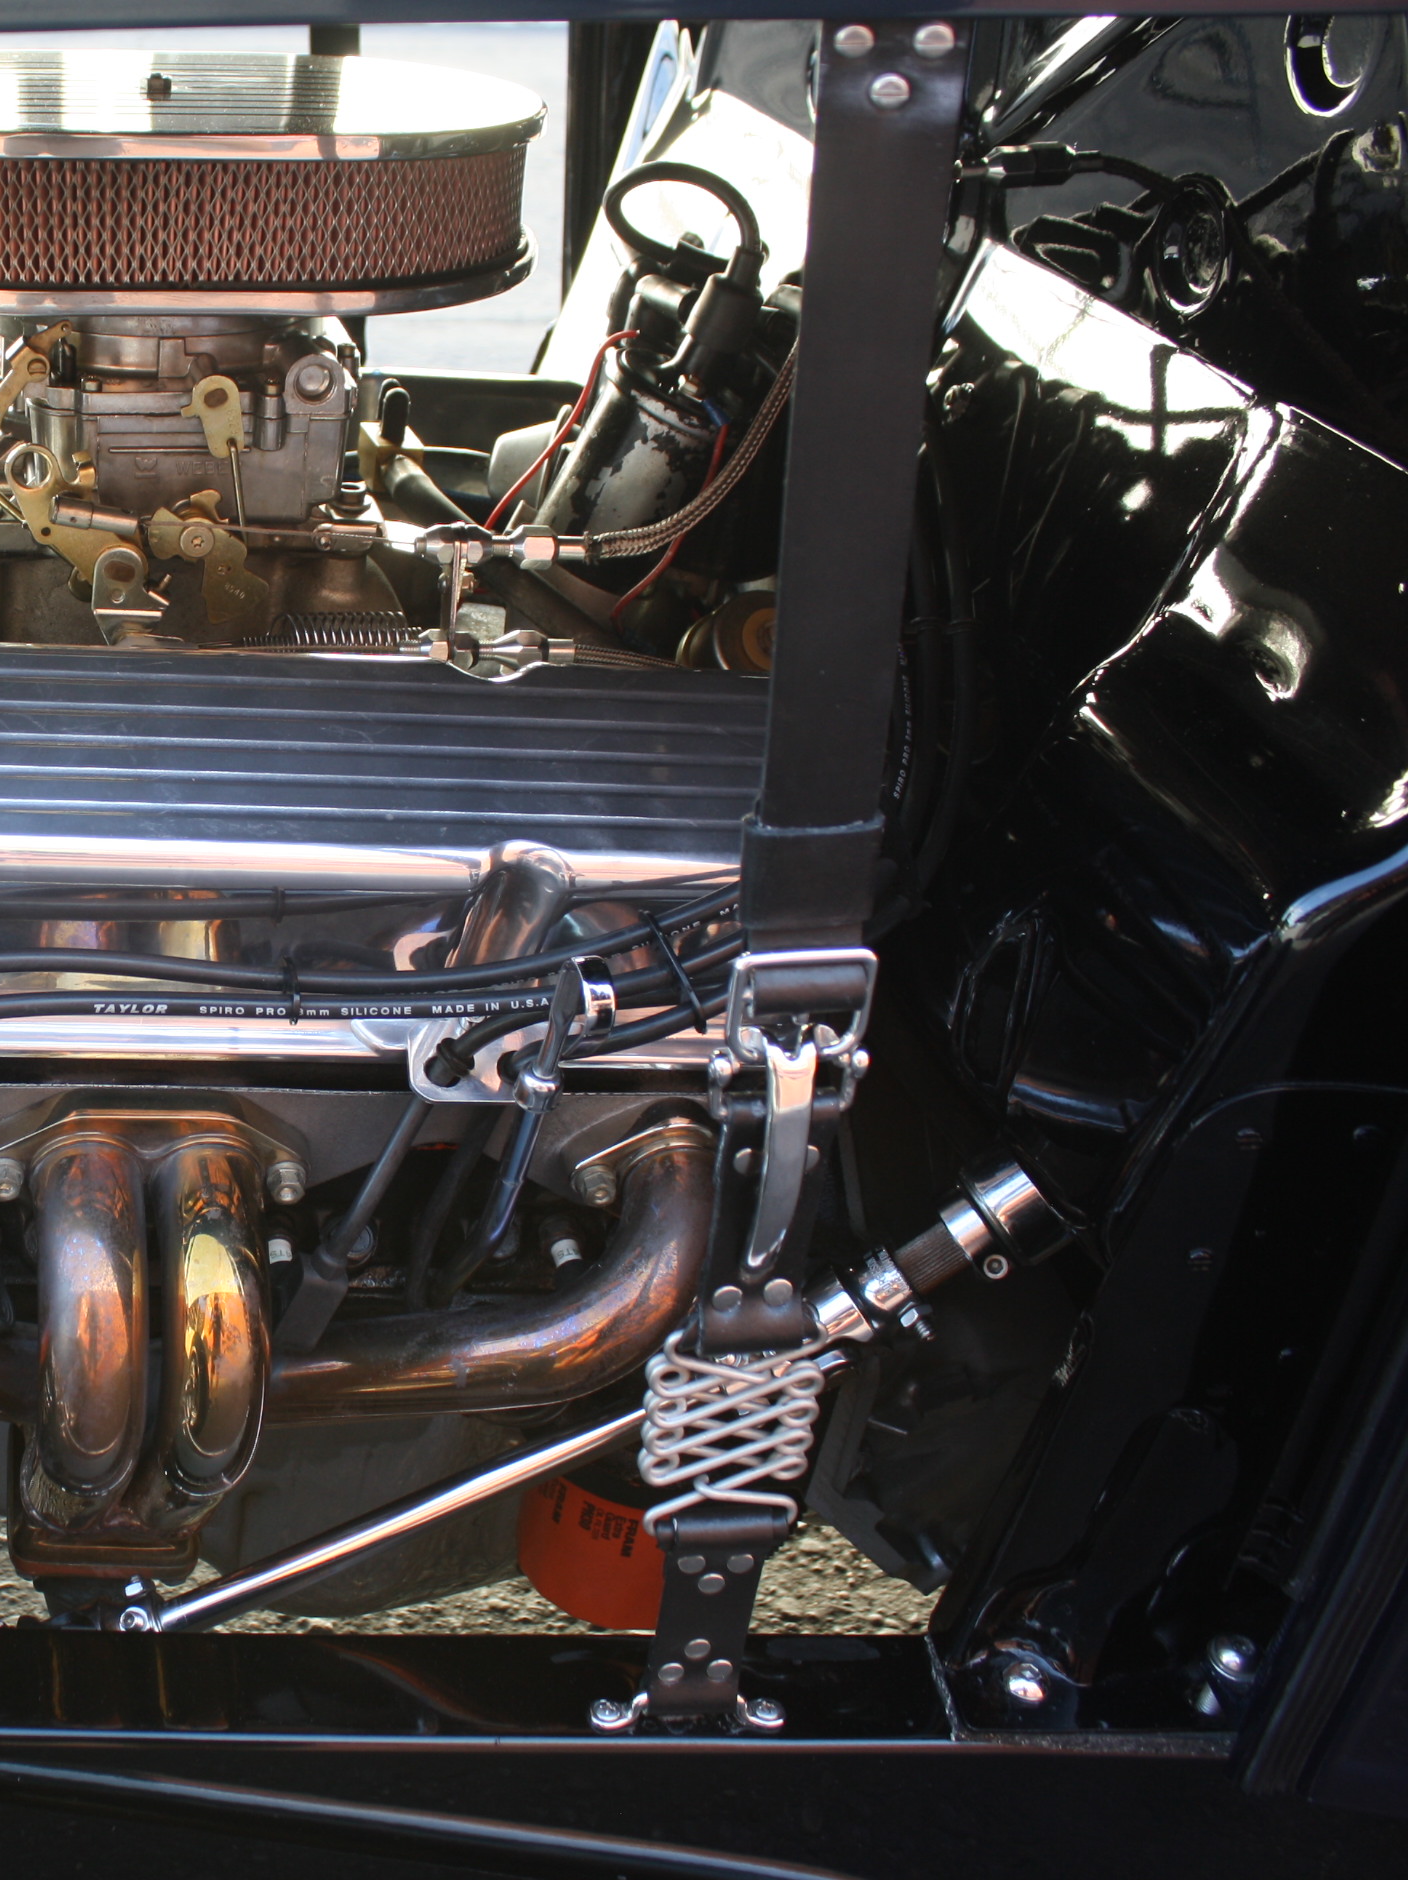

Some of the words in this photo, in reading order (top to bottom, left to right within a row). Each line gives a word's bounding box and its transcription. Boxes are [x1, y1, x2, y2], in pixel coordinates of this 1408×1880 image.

[175, 460, 242, 477] WEBE
[893, 769, 907, 800] SPIRO
[93, 1003, 169, 1015] TAYLOR
[199, 1005, 245, 1015] SPIRO
[255, 1006, 287, 1016] PRO
[340, 1006, 413, 1016] SILICONE
[431, 1004, 475, 1015] MADE
[485, 1001, 500, 1012] IN
[620, 1518, 640, 1558] FRAM
